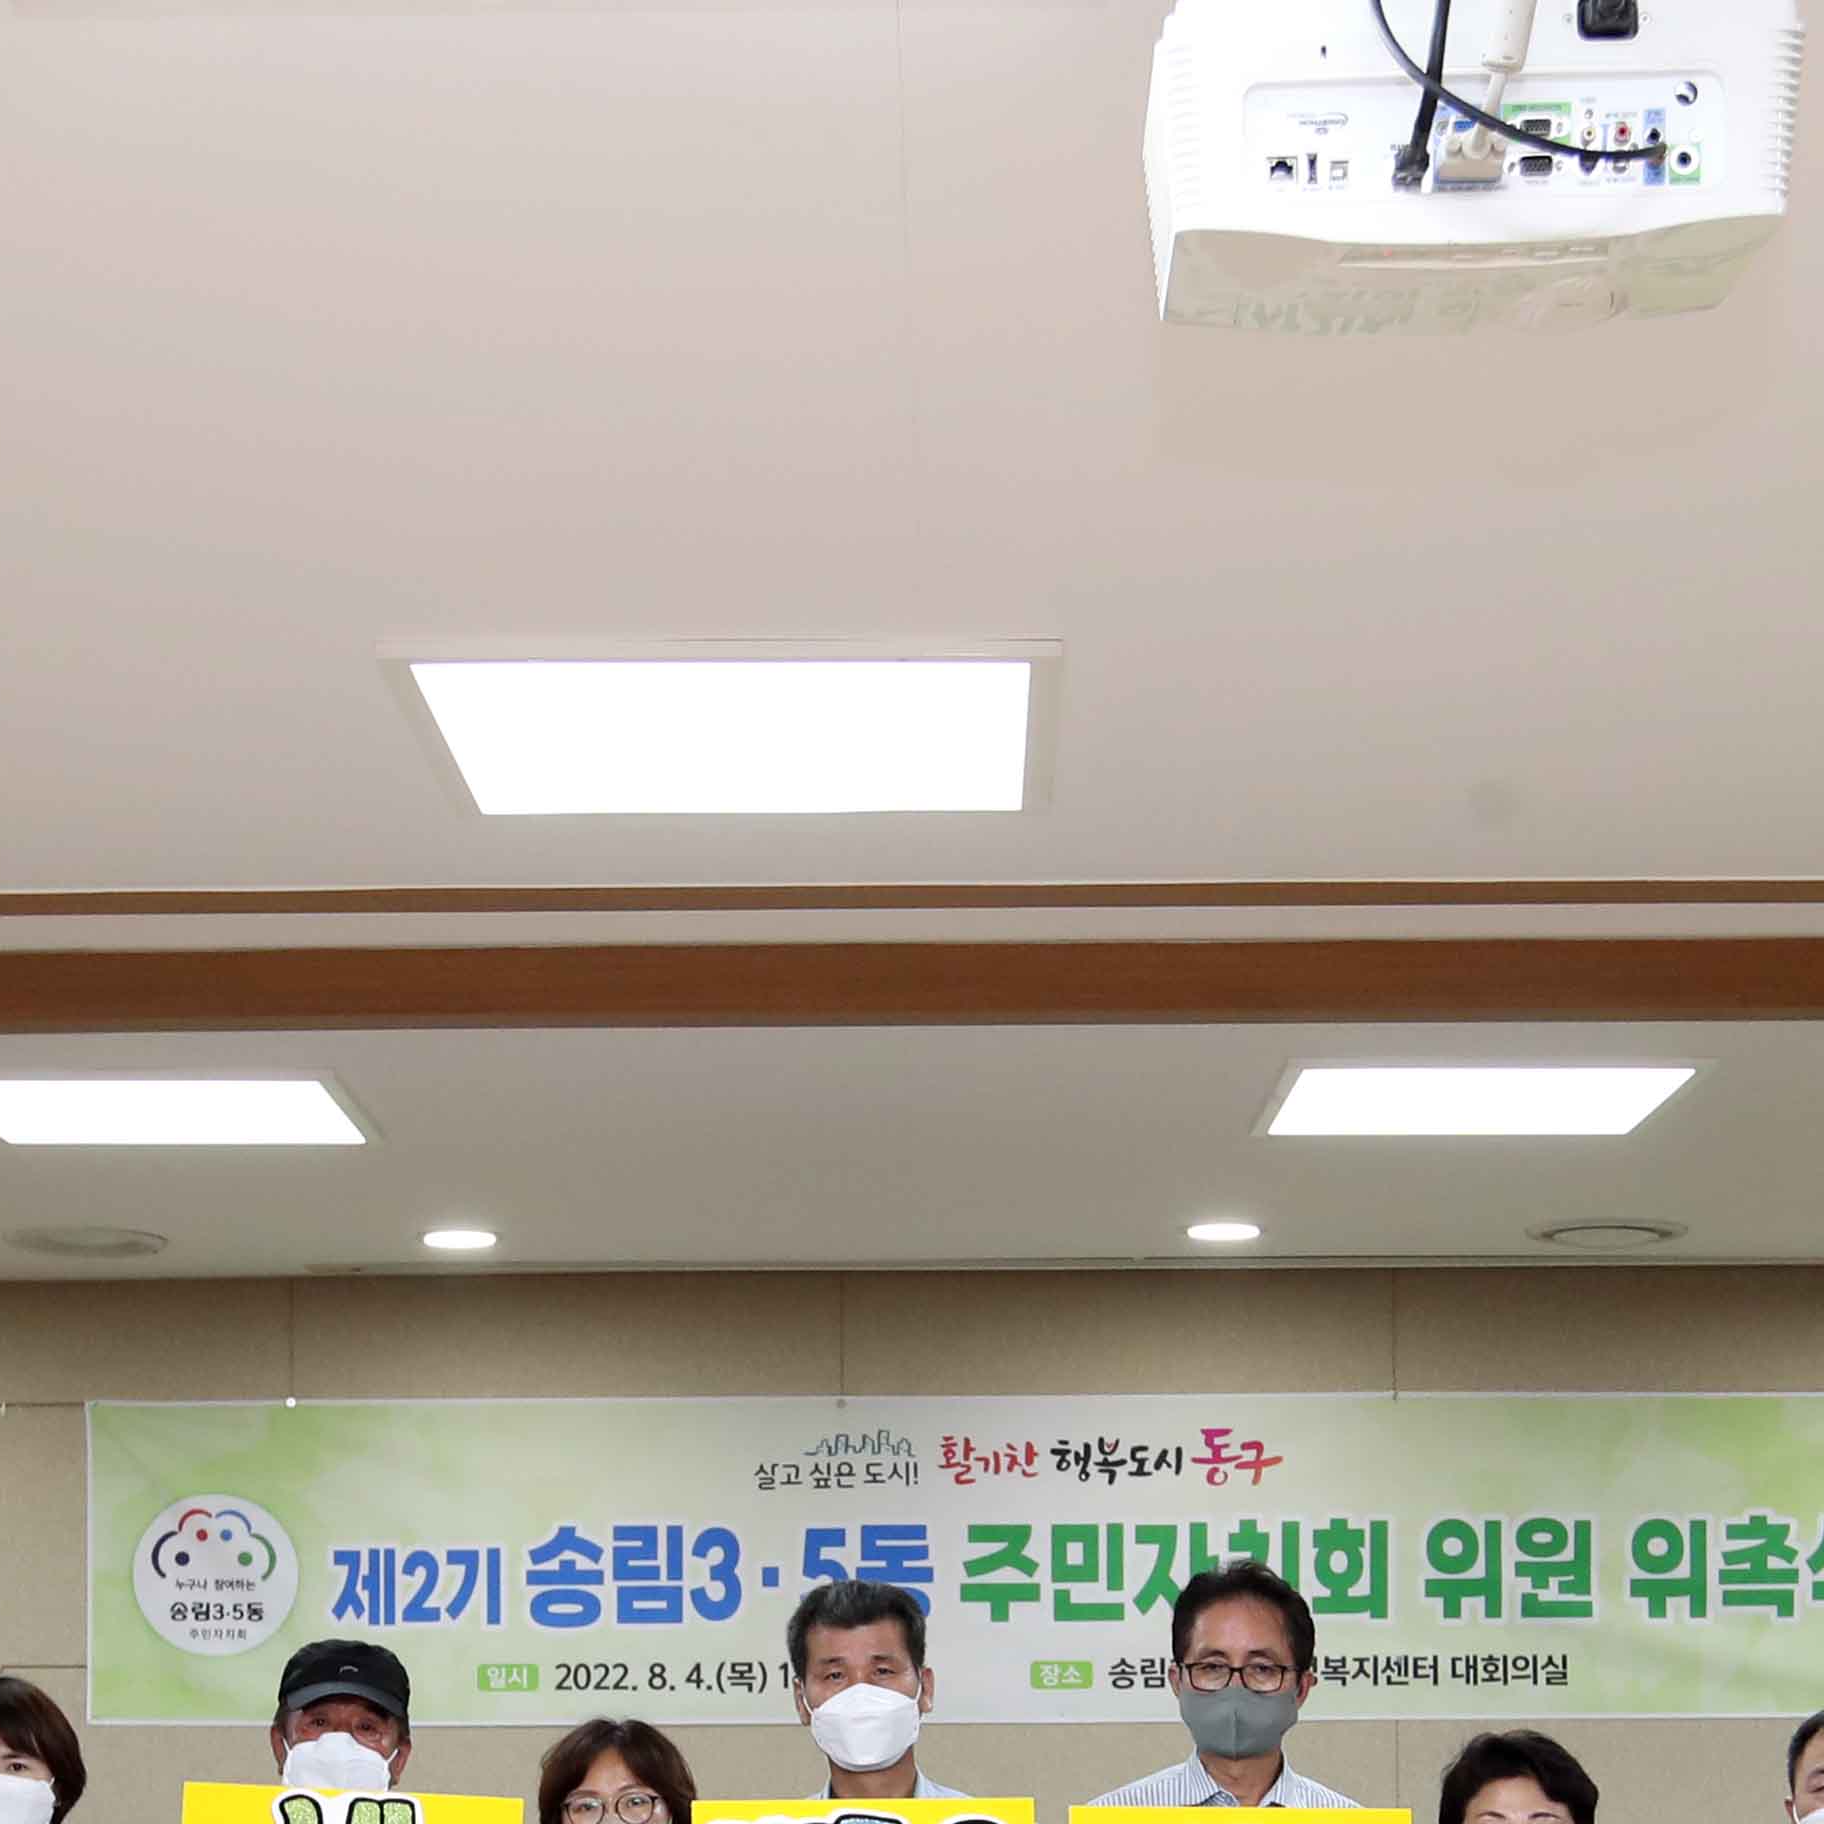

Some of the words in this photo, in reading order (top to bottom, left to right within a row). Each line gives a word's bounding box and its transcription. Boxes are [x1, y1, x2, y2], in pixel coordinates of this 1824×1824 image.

[937, 1434, 1039, 1486] 활기찬
[1050, 1436, 1183, 1486] 행복도시
[1191, 1427, 1283, 1487] 동구
[754, 1460, 804, 1491] 살고
[808, 1459, 857, 1490] 싶은
[863, 1460, 919, 1488] 도시!
[175, 1578, 208, 1591] 누구나
[214, 1578, 256, 1591] 참여하는
[330, 1548, 502, 1626] 제2기
[1424, 1516, 1594, 1620] 위원
[486, 1665, 530, 1689] 일시
[555, 1663, 638, 1692] 2022.
[648, 1663, 677, 1692] 8.
[686, 1661, 768, 1696] 4.(목)
[1037, 1662, 1085, 1685] 장소
[1450, 1653, 1569, 1687] 대회의실
